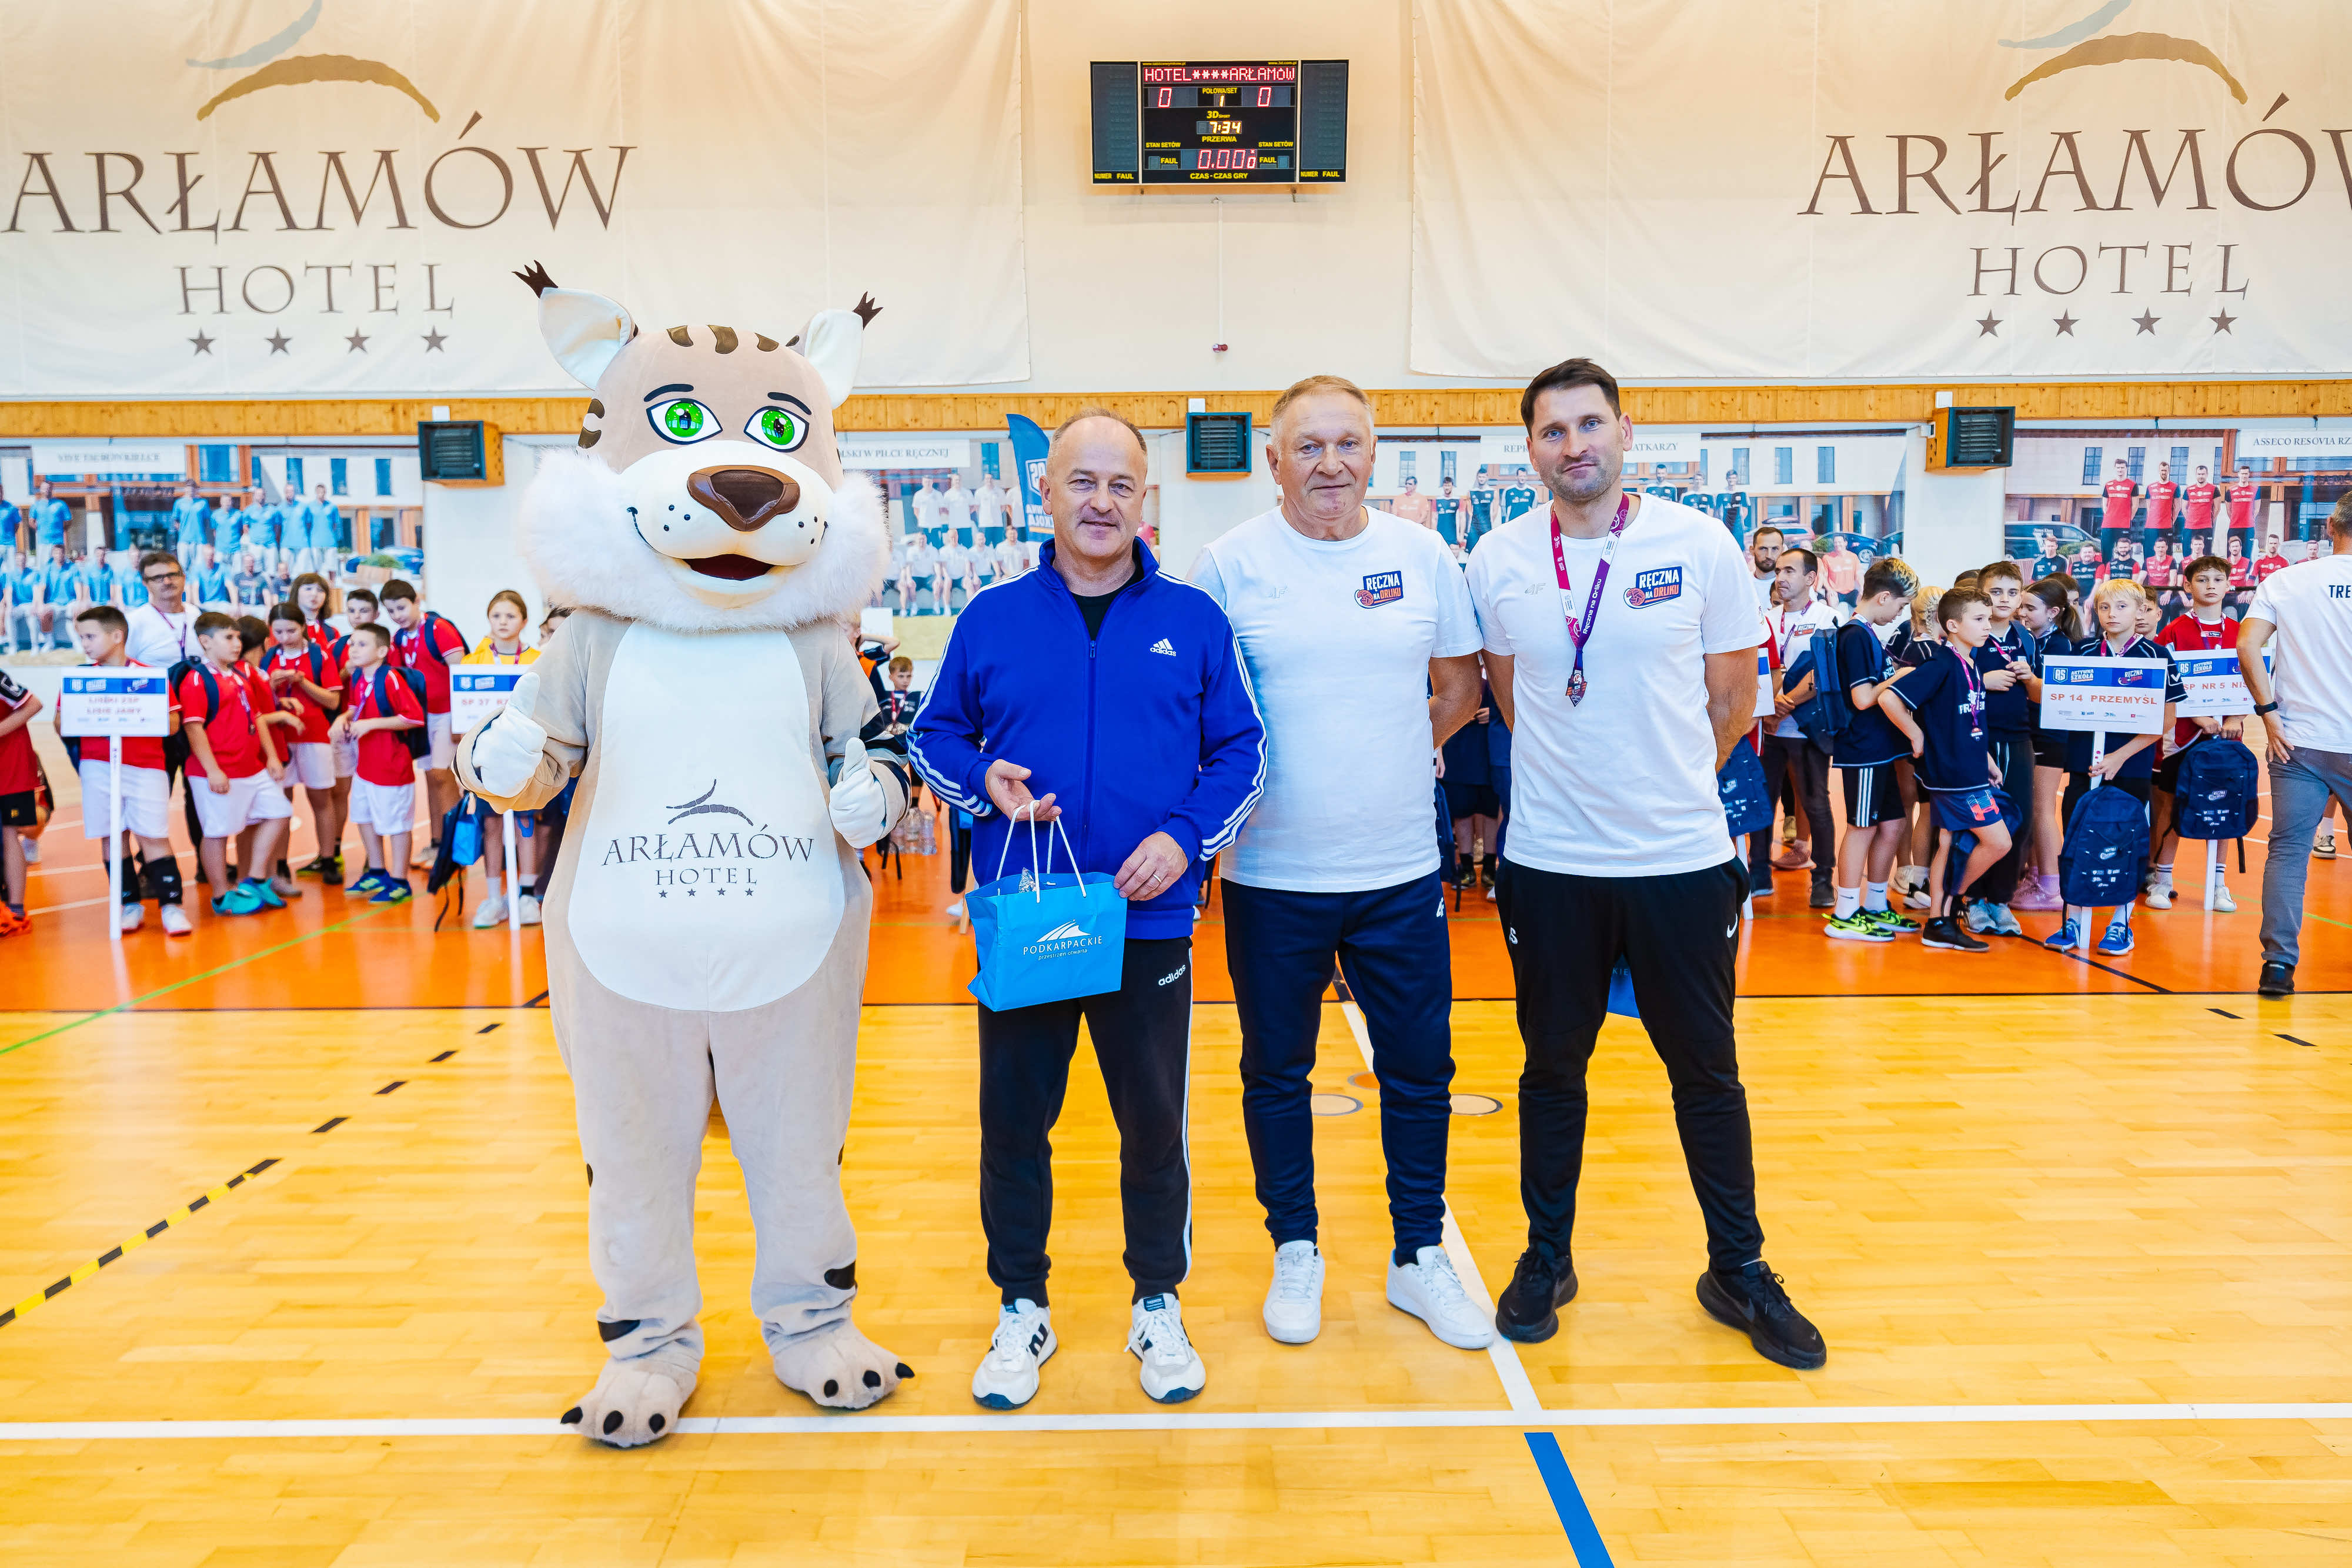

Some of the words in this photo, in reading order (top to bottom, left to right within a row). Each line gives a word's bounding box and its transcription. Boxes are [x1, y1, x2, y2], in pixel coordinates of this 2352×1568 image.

[1158, 87, 1172, 108] 0
[1219, 95, 1225, 108] 1
[1257, 86, 1272, 108] 0
[1207, 111, 1219, 119] 3D
[1209, 121, 1242, 135] 7:34
[1, 111, 637, 244] ARŁAMÓW
[1967, 241, 2249, 300] HOTEL
[176, 260, 454, 318] HOTEL
[1632, 443, 1678, 452] ATKARZY
[2253, 437, 2291, 446] ASSECO
[2294, 437, 2336, 446] RESOVIA
[840, 449, 863, 457] LSKI
[906, 447, 948, 459] RĘCZNEJ
[1366, 573, 1400, 591] RĘCZNA
[1639, 569, 1679, 589] RĘCZNA
[1379, 587, 1401, 599] ORLIKU
[1592, 579, 1602, 599] Orliku
[1653, 584, 1679, 598] ORLIKU
[1591, 600, 1596, 609] na
[1583, 610, 1593, 634] Ręczna
[1150, 647, 1177, 657] adidas
[2091, 694, 2157, 704] PRZEMYŚL
[602, 824, 814, 866] ARŁAMÓW
[655, 867, 757, 886] HOTEL
[1023, 935, 1103, 955] PODKARPACKIE
[1158, 964, 1185, 986] adidas
